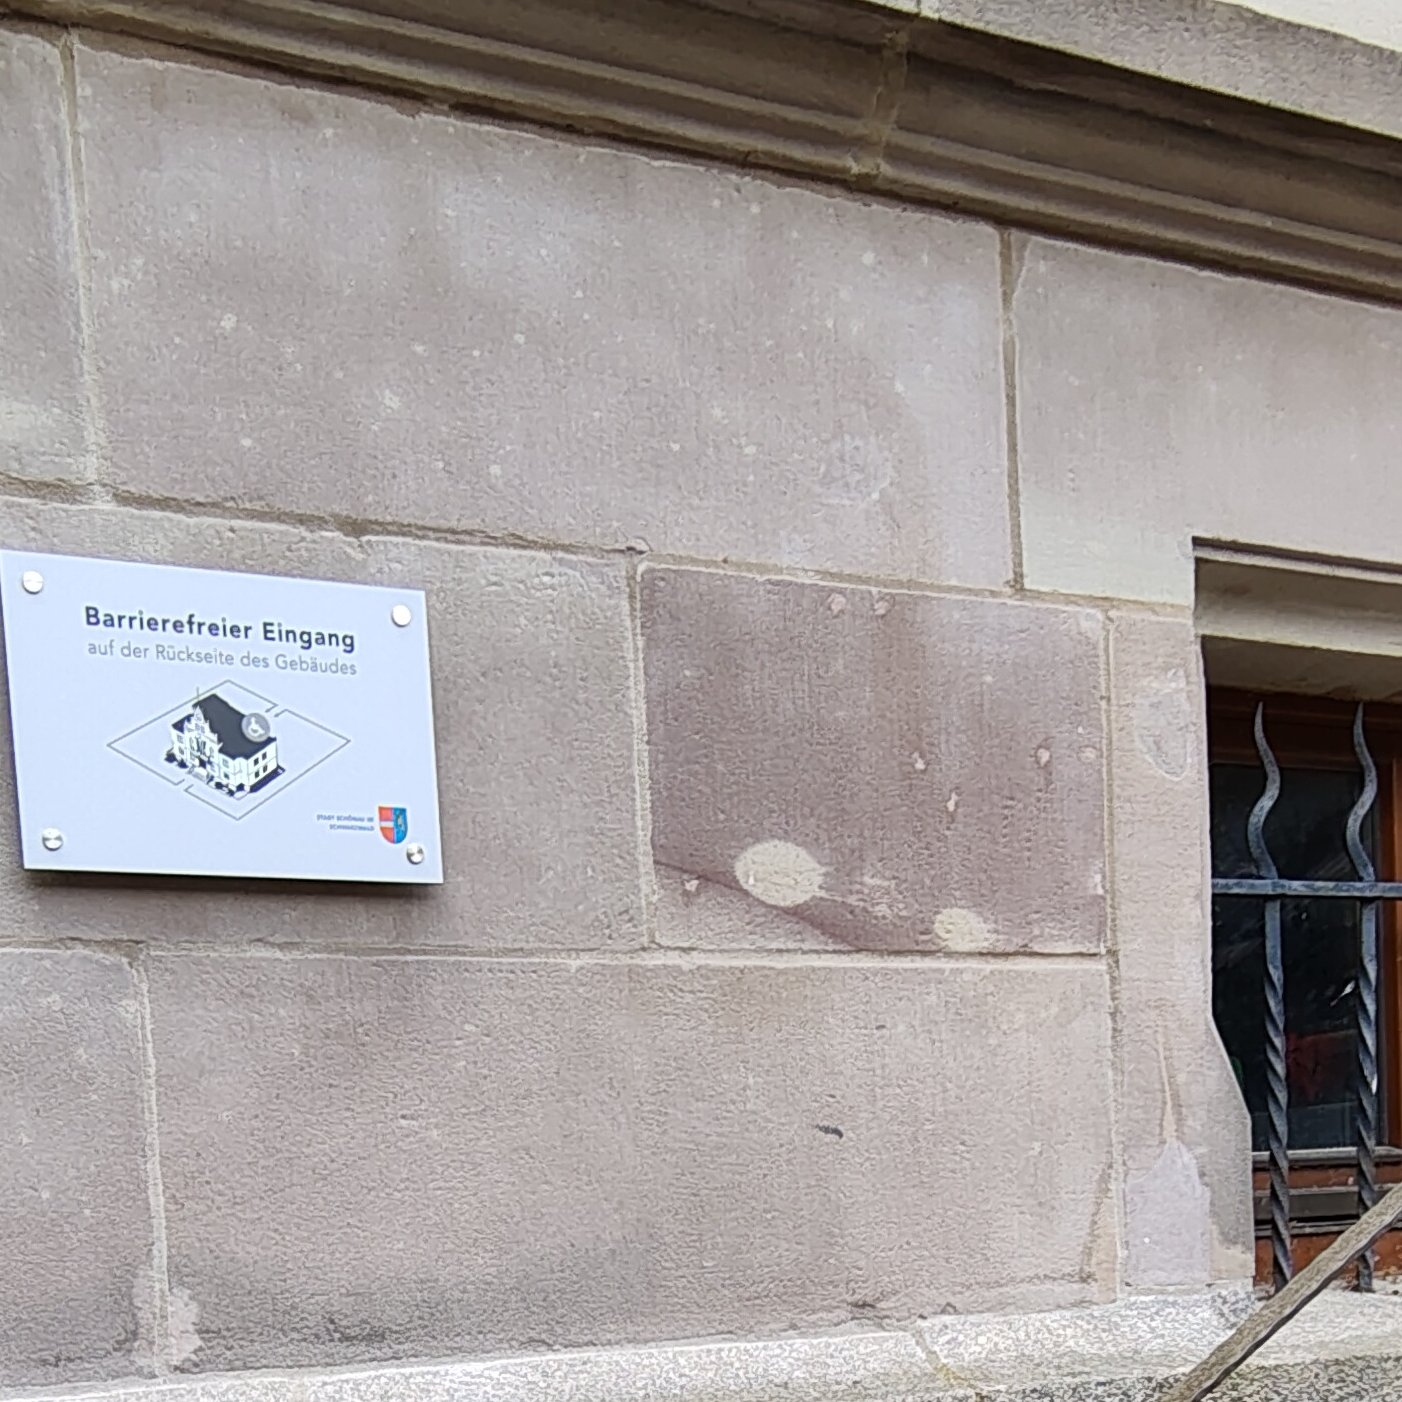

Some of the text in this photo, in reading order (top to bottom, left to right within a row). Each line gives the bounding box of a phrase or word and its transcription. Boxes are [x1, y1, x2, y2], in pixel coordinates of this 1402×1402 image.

[84, 605, 356, 655] Barrierefreier Eingang
[87, 638, 358, 676] auf der Rückseite des Gebäudes
